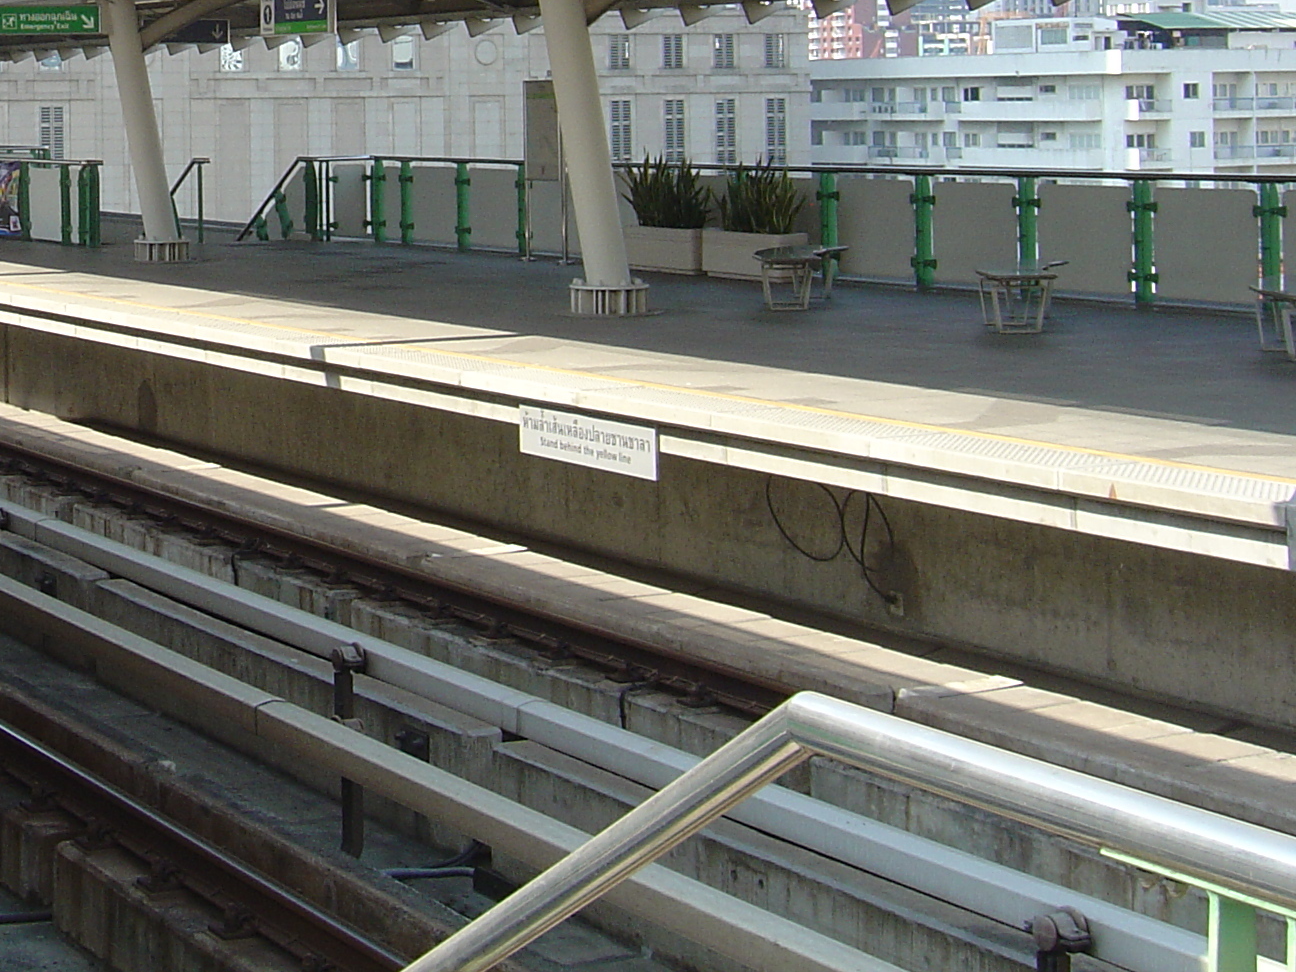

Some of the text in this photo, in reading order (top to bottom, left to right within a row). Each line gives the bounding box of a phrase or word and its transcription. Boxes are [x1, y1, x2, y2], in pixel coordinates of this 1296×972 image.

[20, 23, 55, 31] Emergency
[540, 436, 632, 465] Stand behind the yellow line
